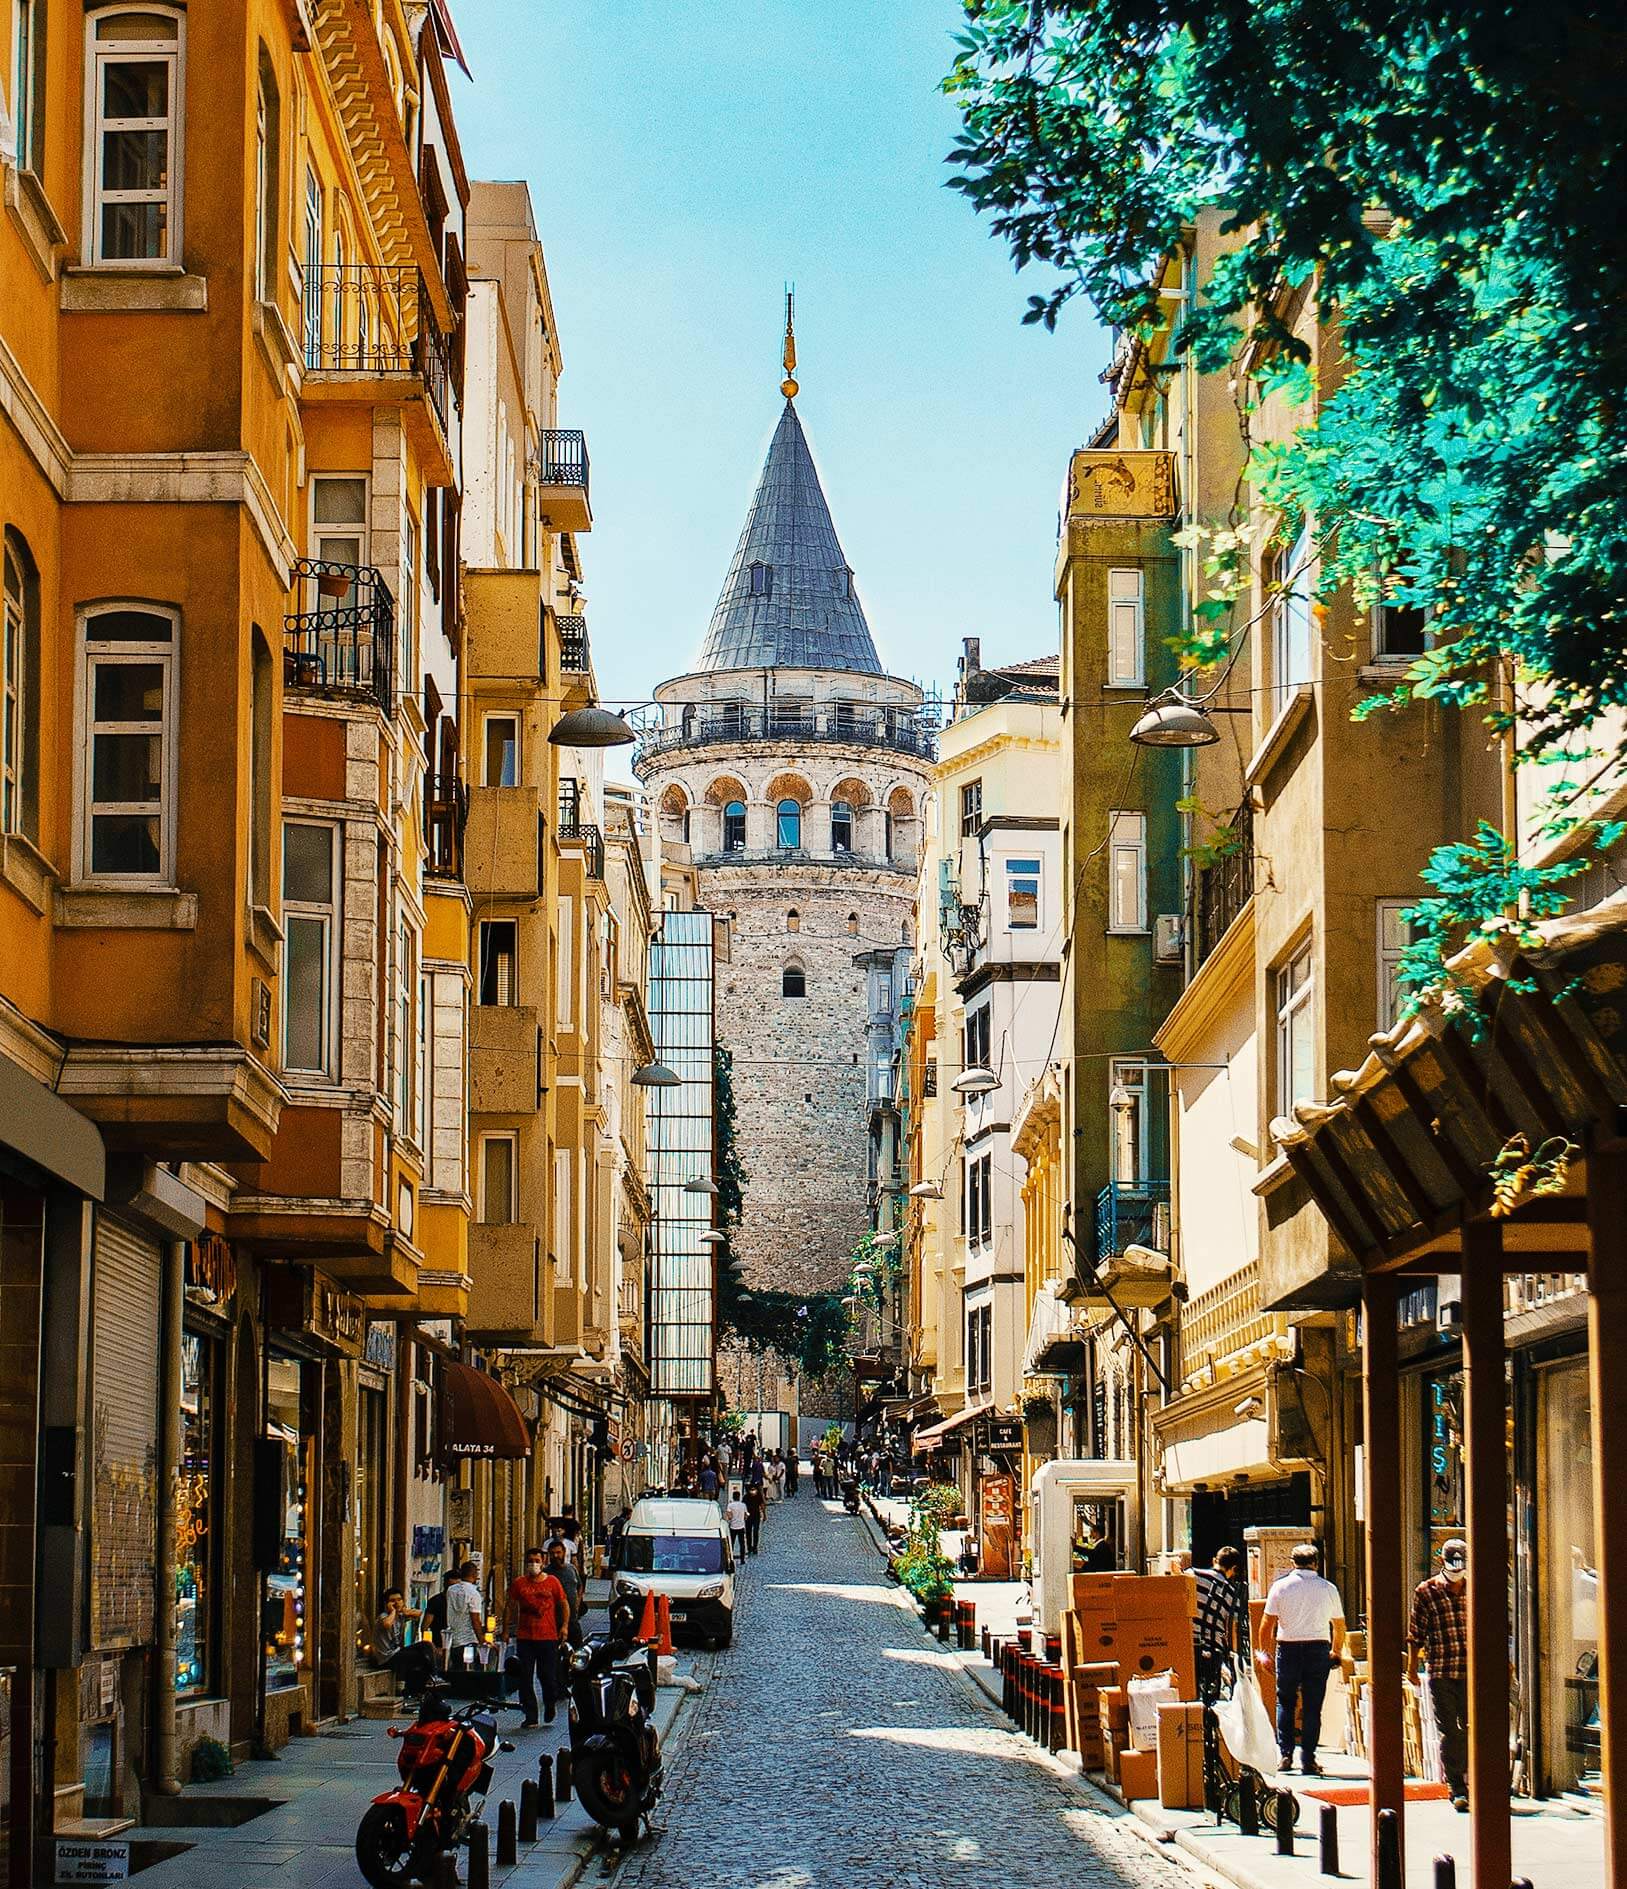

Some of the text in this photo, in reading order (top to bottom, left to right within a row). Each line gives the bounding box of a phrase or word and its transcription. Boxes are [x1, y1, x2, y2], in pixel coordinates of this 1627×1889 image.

[482, 1444, 495, 1454] 34
[990, 1441, 1022, 1449] RESTAURANT
[58, 1845, 127, 1859] ÖZDEN BRONZ
